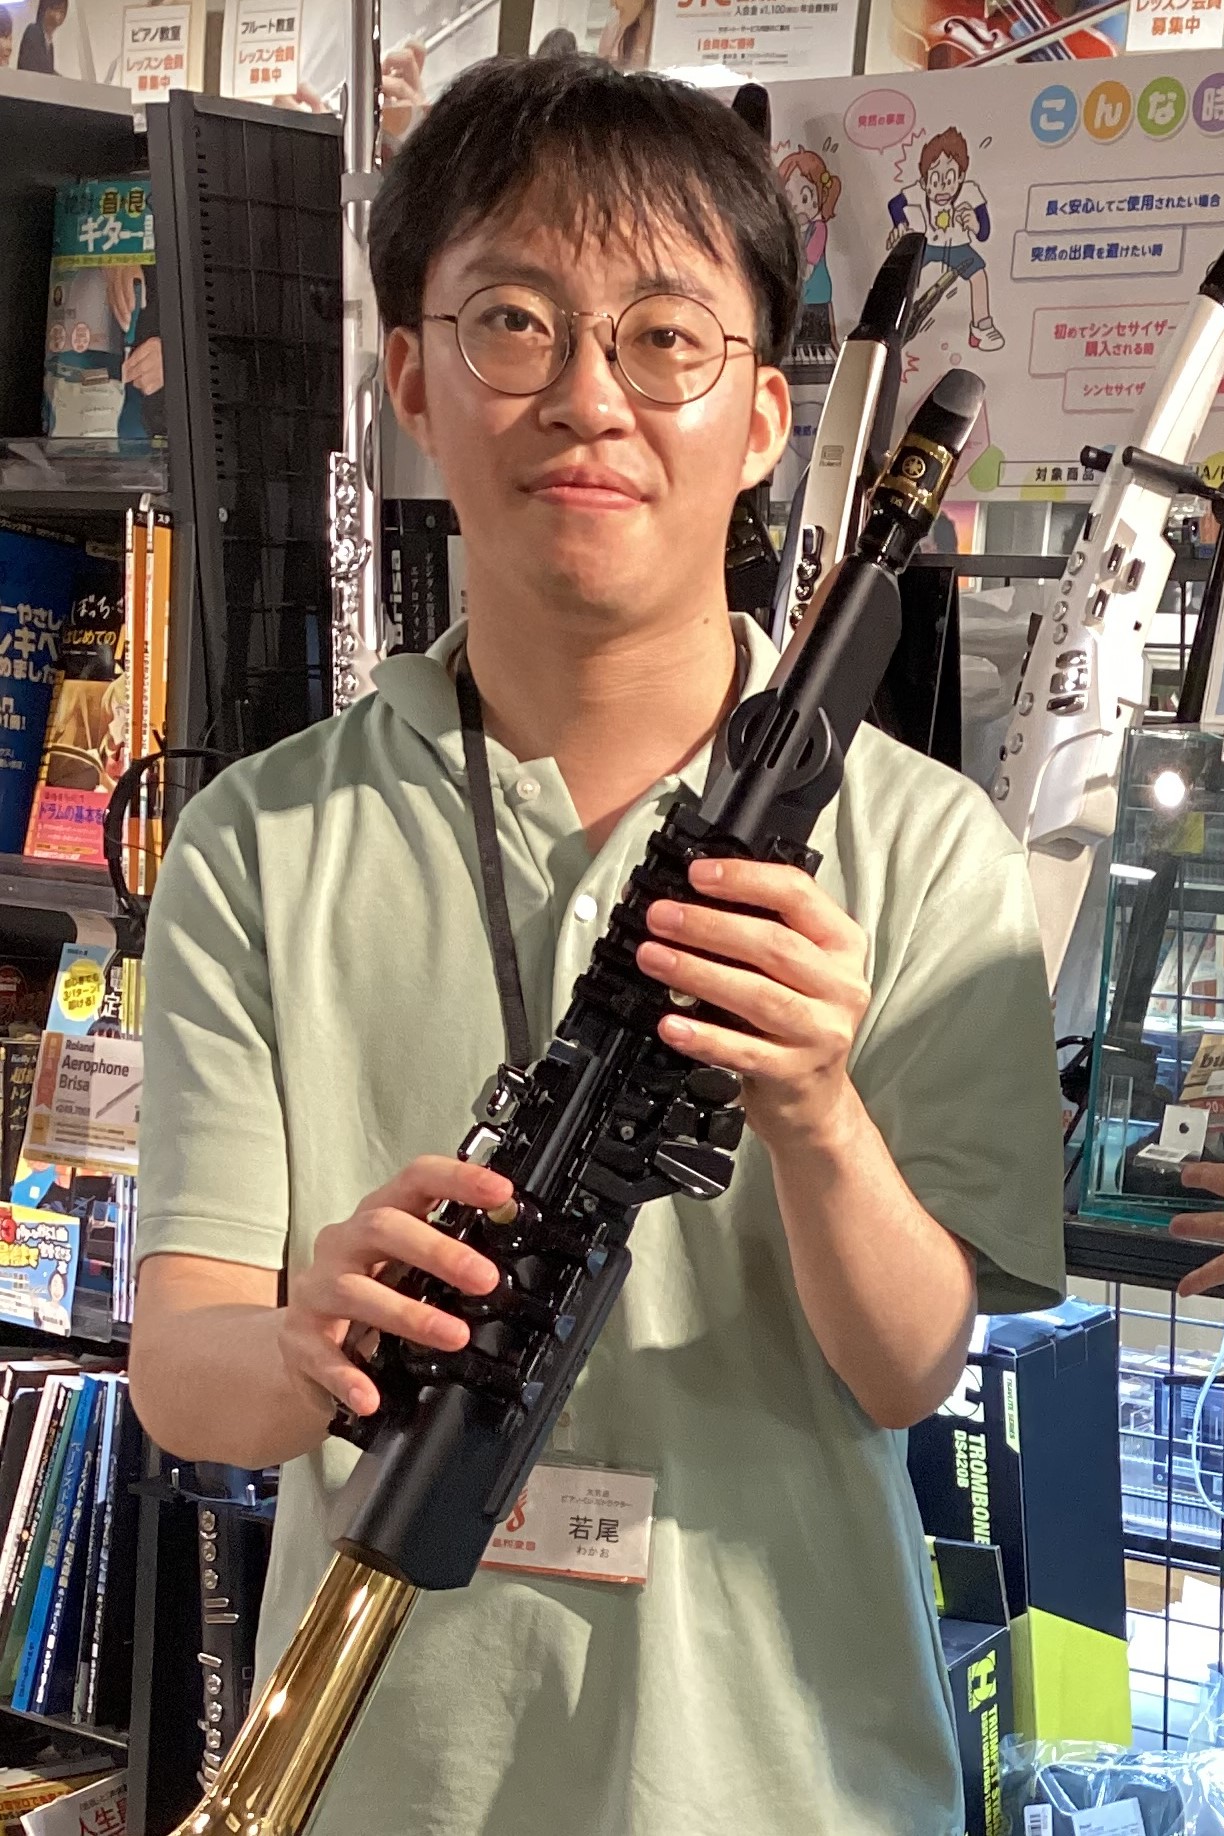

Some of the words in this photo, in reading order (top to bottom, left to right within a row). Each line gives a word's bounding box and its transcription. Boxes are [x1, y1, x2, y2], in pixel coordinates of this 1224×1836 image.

[131, 26, 181, 42] ピアノ教室
[241, 17, 295, 34] フルート教室
[1152, 16, 1200, 35] 募集中
[127, 54, 184, 71] レッスン会員
[239, 46, 295, 64] レッスン会員
[250, 68, 282, 85] 募集中
[1045, 193, 1221, 216] 長く安心してご使用されたい場合
[1030, 242, 1164, 262] 突然の出費を避けたい時
[1085, 340, 1154, 357] 購入される時
[1035, 466, 1095, 482] 対象商品
[62, 627, 117, 645] はじめての
[65, 1040, 95, 1053] Roland
[61, 1055, 130, 1077] Aerophone
[59, 1074, 90, 1092] Brisa
[954, 1429, 969, 1489] DS420B
[969, 1433, 991, 1546] TROMBONE
[569, 1514, 619, 1544] 若尾
[576, 1546, 610, 1559] わかお
